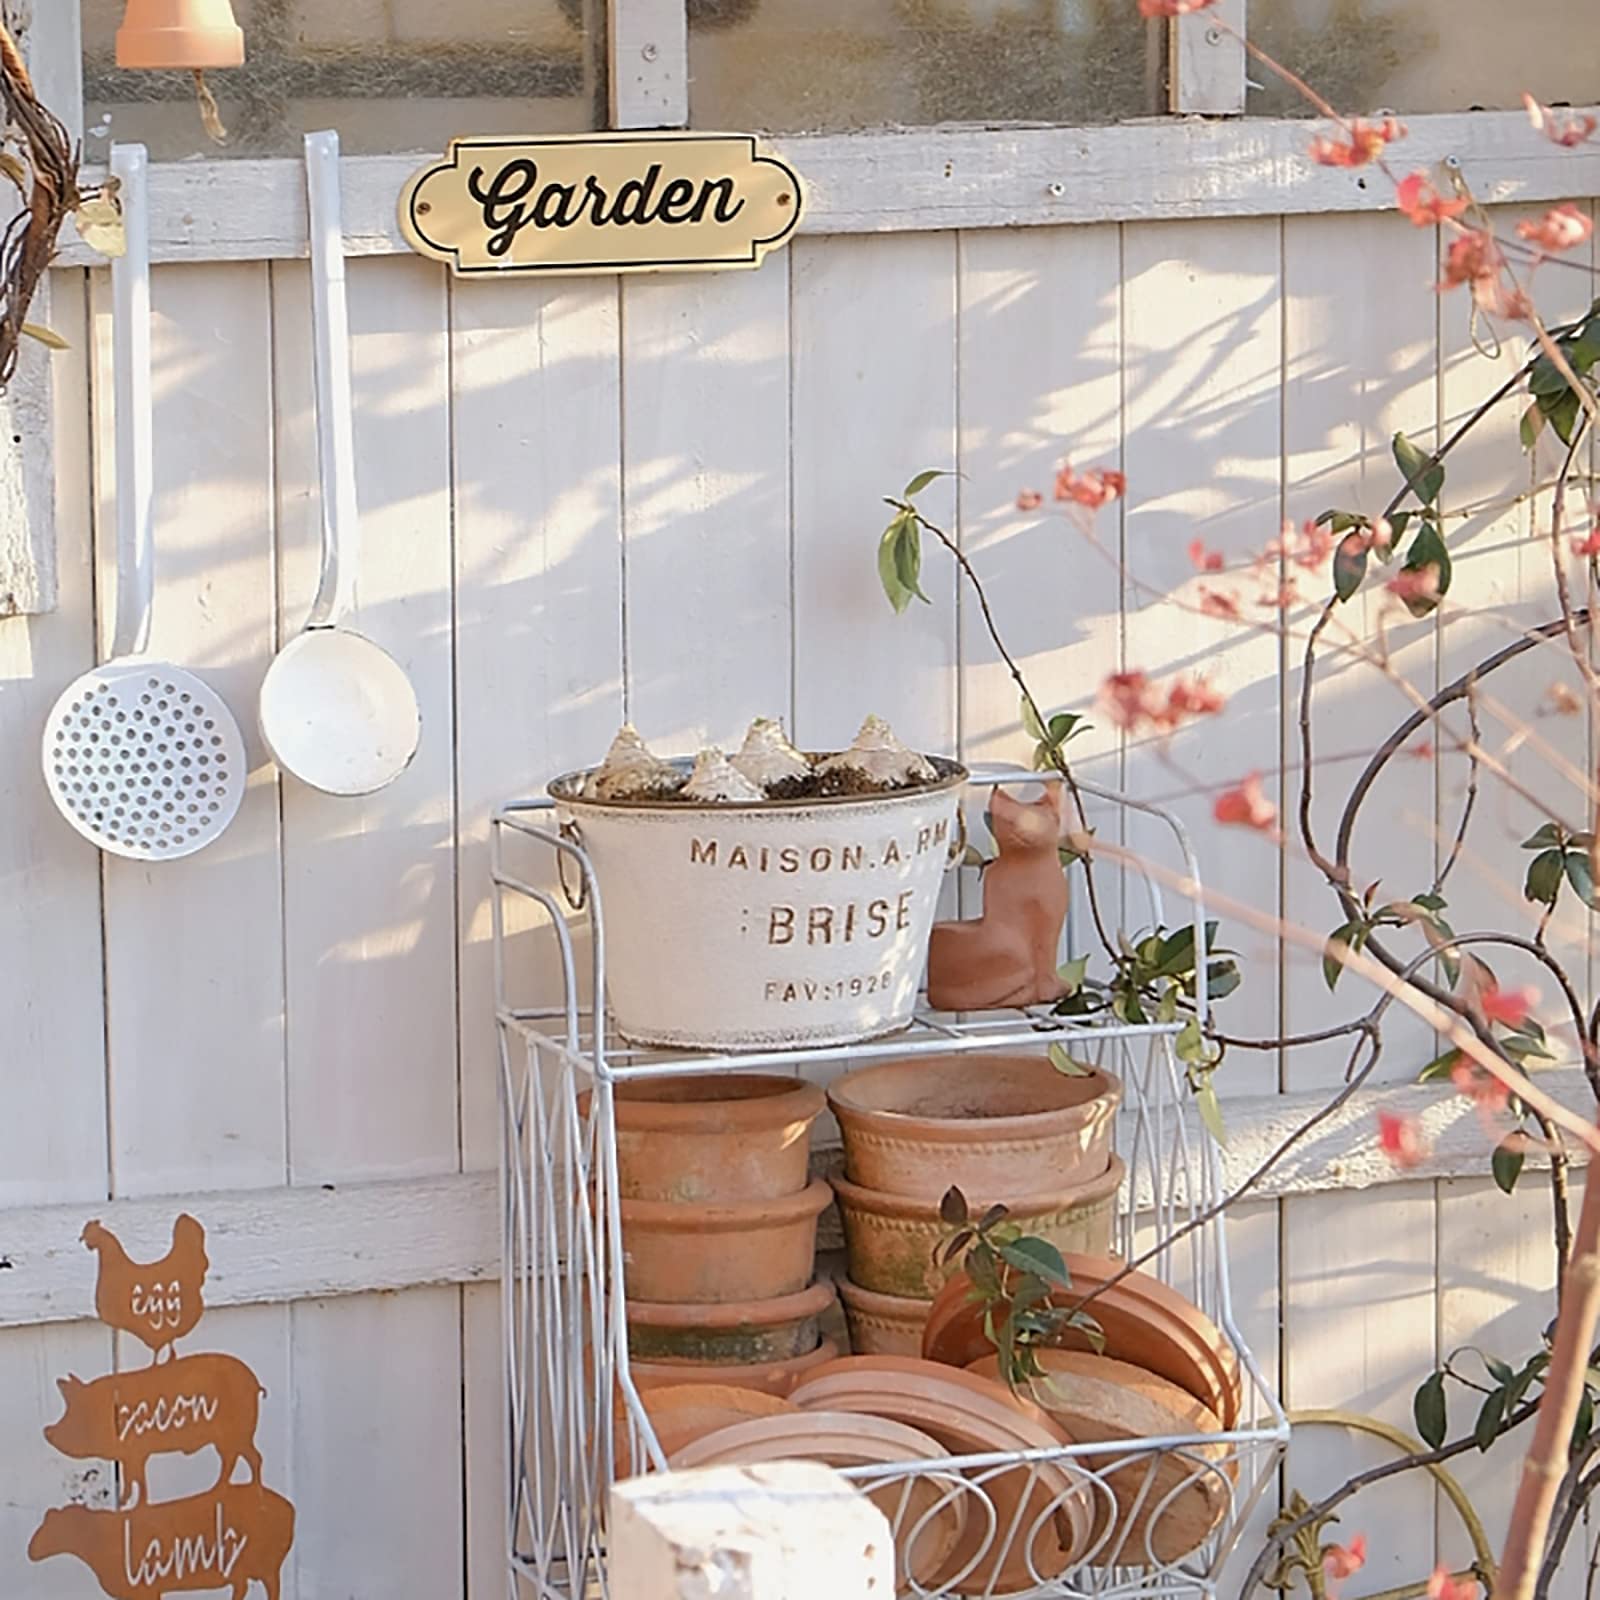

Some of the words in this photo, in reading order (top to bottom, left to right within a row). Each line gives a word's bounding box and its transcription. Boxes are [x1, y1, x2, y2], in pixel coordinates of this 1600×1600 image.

[468, 158, 745, 257] Garden
[131, 1280, 182, 1329] egg
[115, 1389, 218, 1441] bacon
[124, 1502, 248, 1586] lamb
